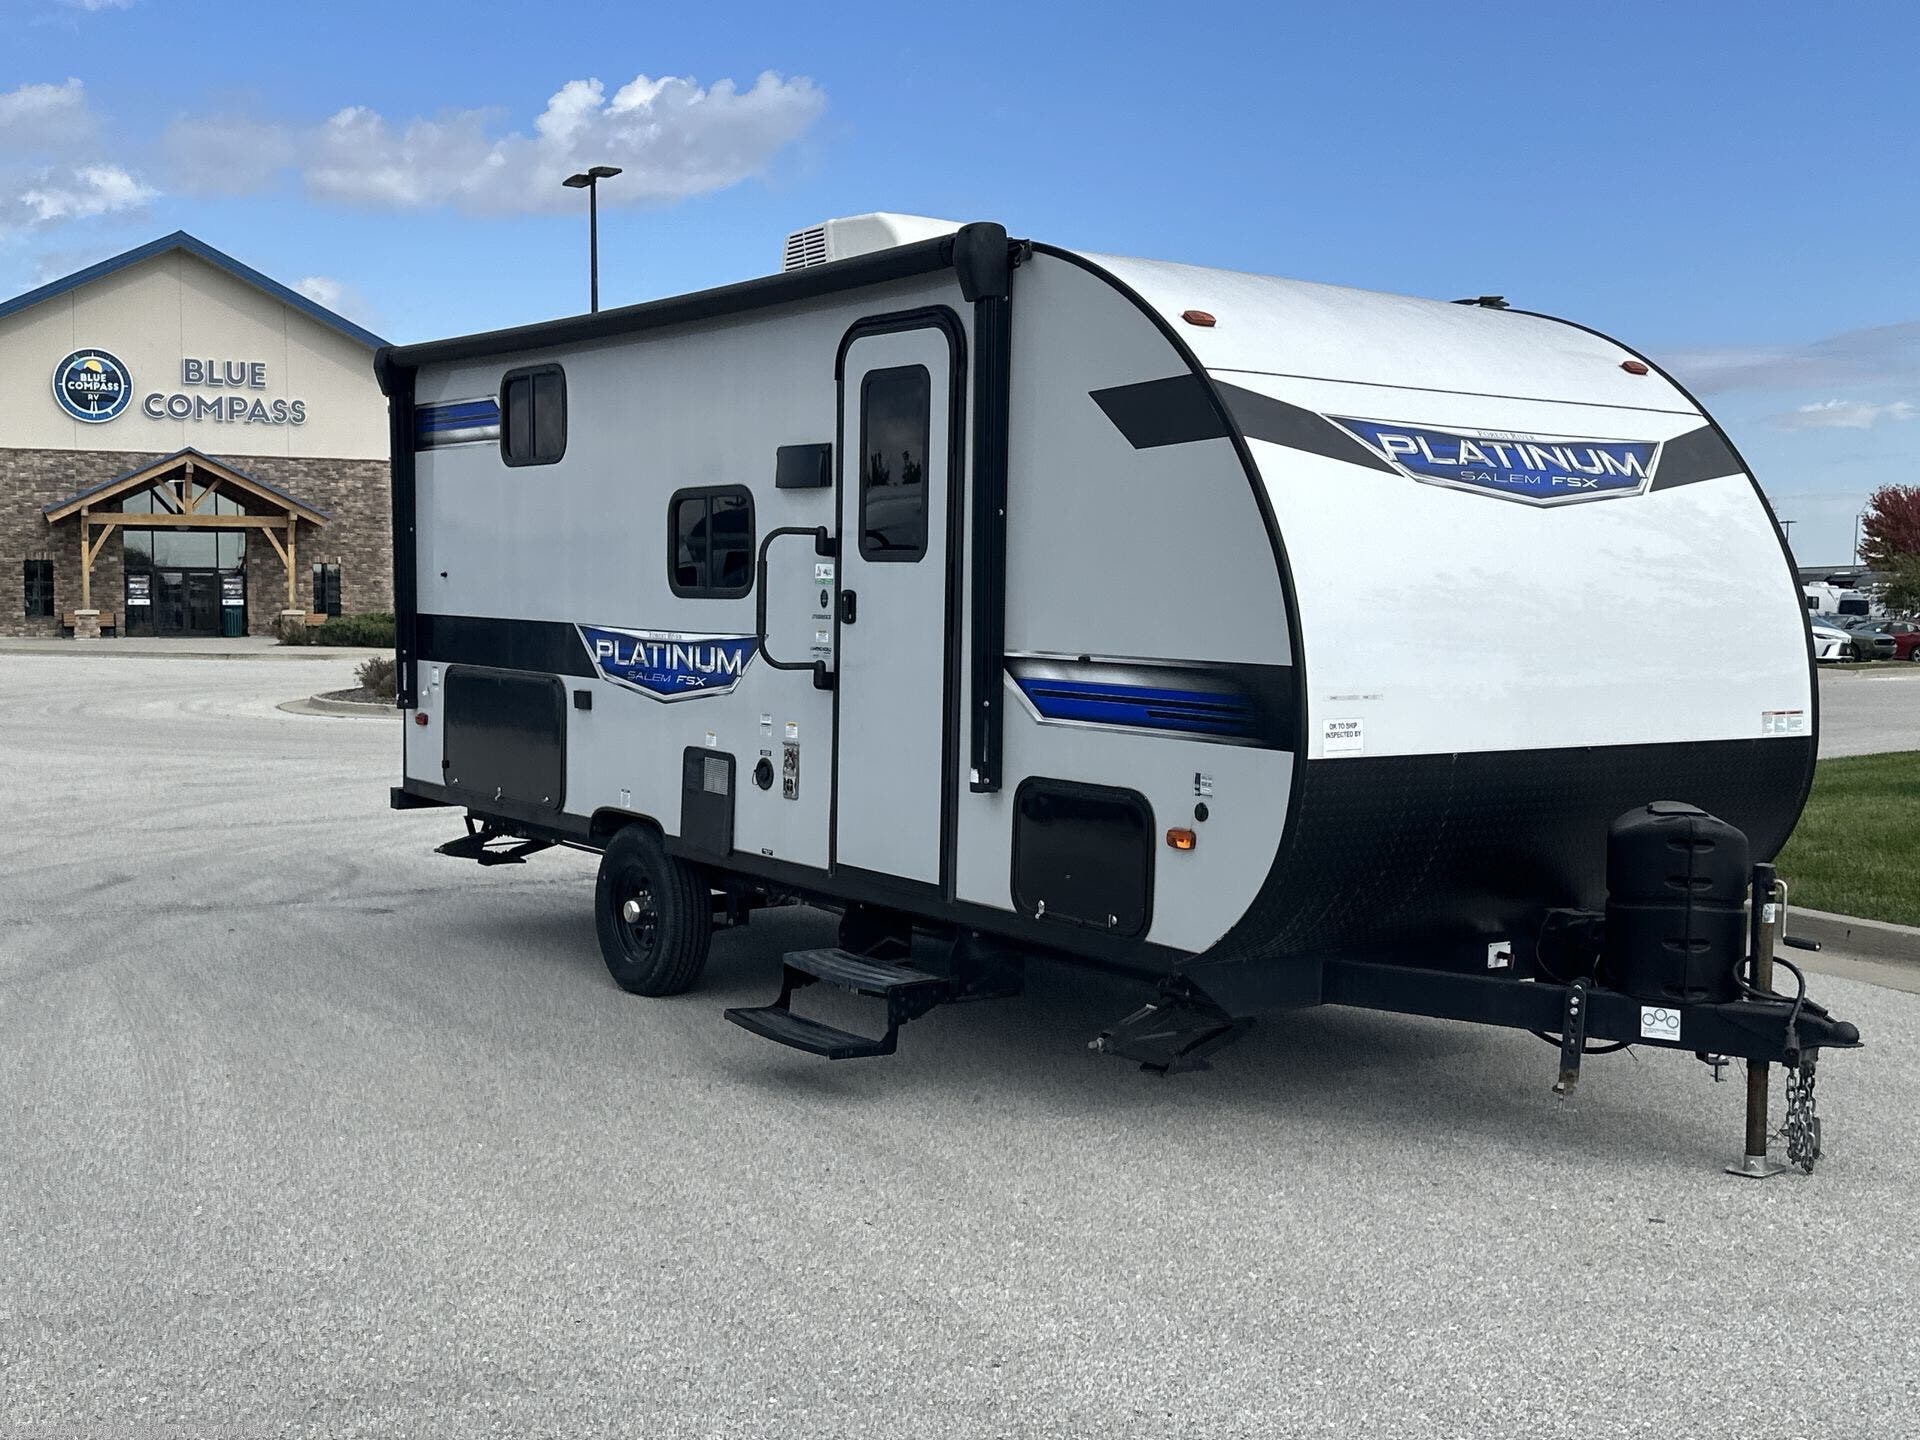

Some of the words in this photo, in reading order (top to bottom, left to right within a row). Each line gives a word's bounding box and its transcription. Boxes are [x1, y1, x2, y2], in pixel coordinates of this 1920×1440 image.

[80, 372, 107, 382] BLUE
[183, 358, 266, 388] BLUE
[67, 381, 119, 391] COMPASS
[143, 392, 308, 425] COMPASS
[1376, 432, 1648, 479] PLATINUM
[1460, 470, 1541, 485] SALEM
[1552, 476, 1598, 489] FSX
[595, 638, 743, 676] PLATINUM
[627, 670, 671, 683] SALEM
[676, 675, 707, 687] FSX
[1325, 731, 1353, 739] INSPECTED
